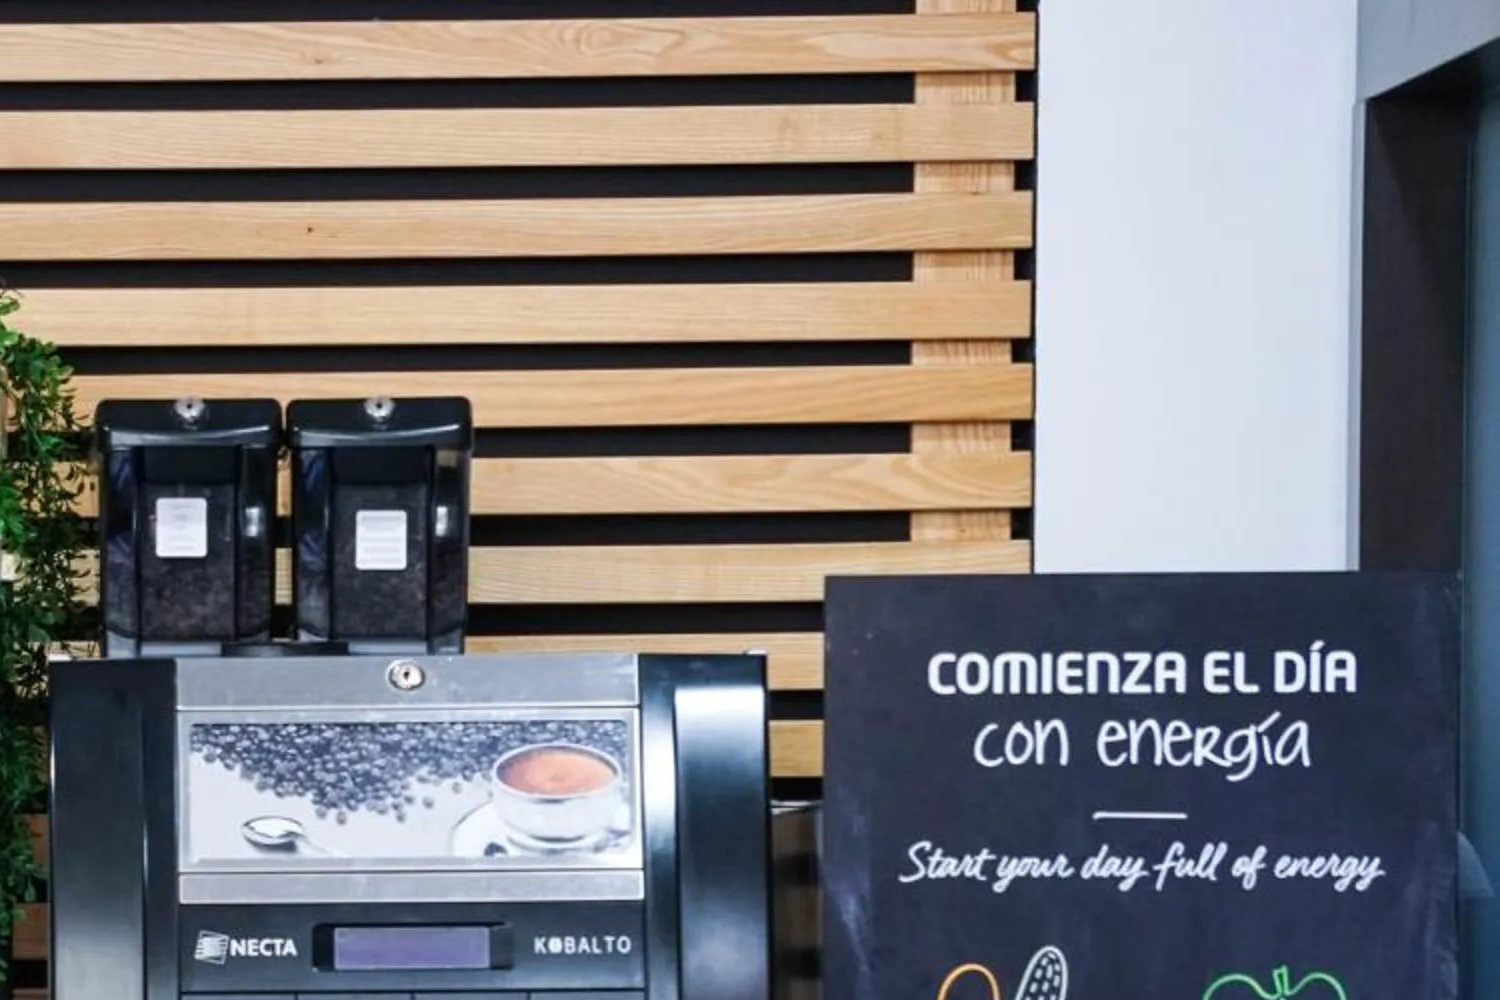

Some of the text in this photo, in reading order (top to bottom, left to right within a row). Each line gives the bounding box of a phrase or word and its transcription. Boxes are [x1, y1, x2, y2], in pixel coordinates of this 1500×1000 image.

[927, 641, 1357, 695] COMIENZA EL DÍA
[973, 711, 1311, 782] con energía
[898, 840, 1386, 893] Start your day full of energy
[229, 938, 298, 957] NECTA
[533, 935, 632, 955] KOBALTO
